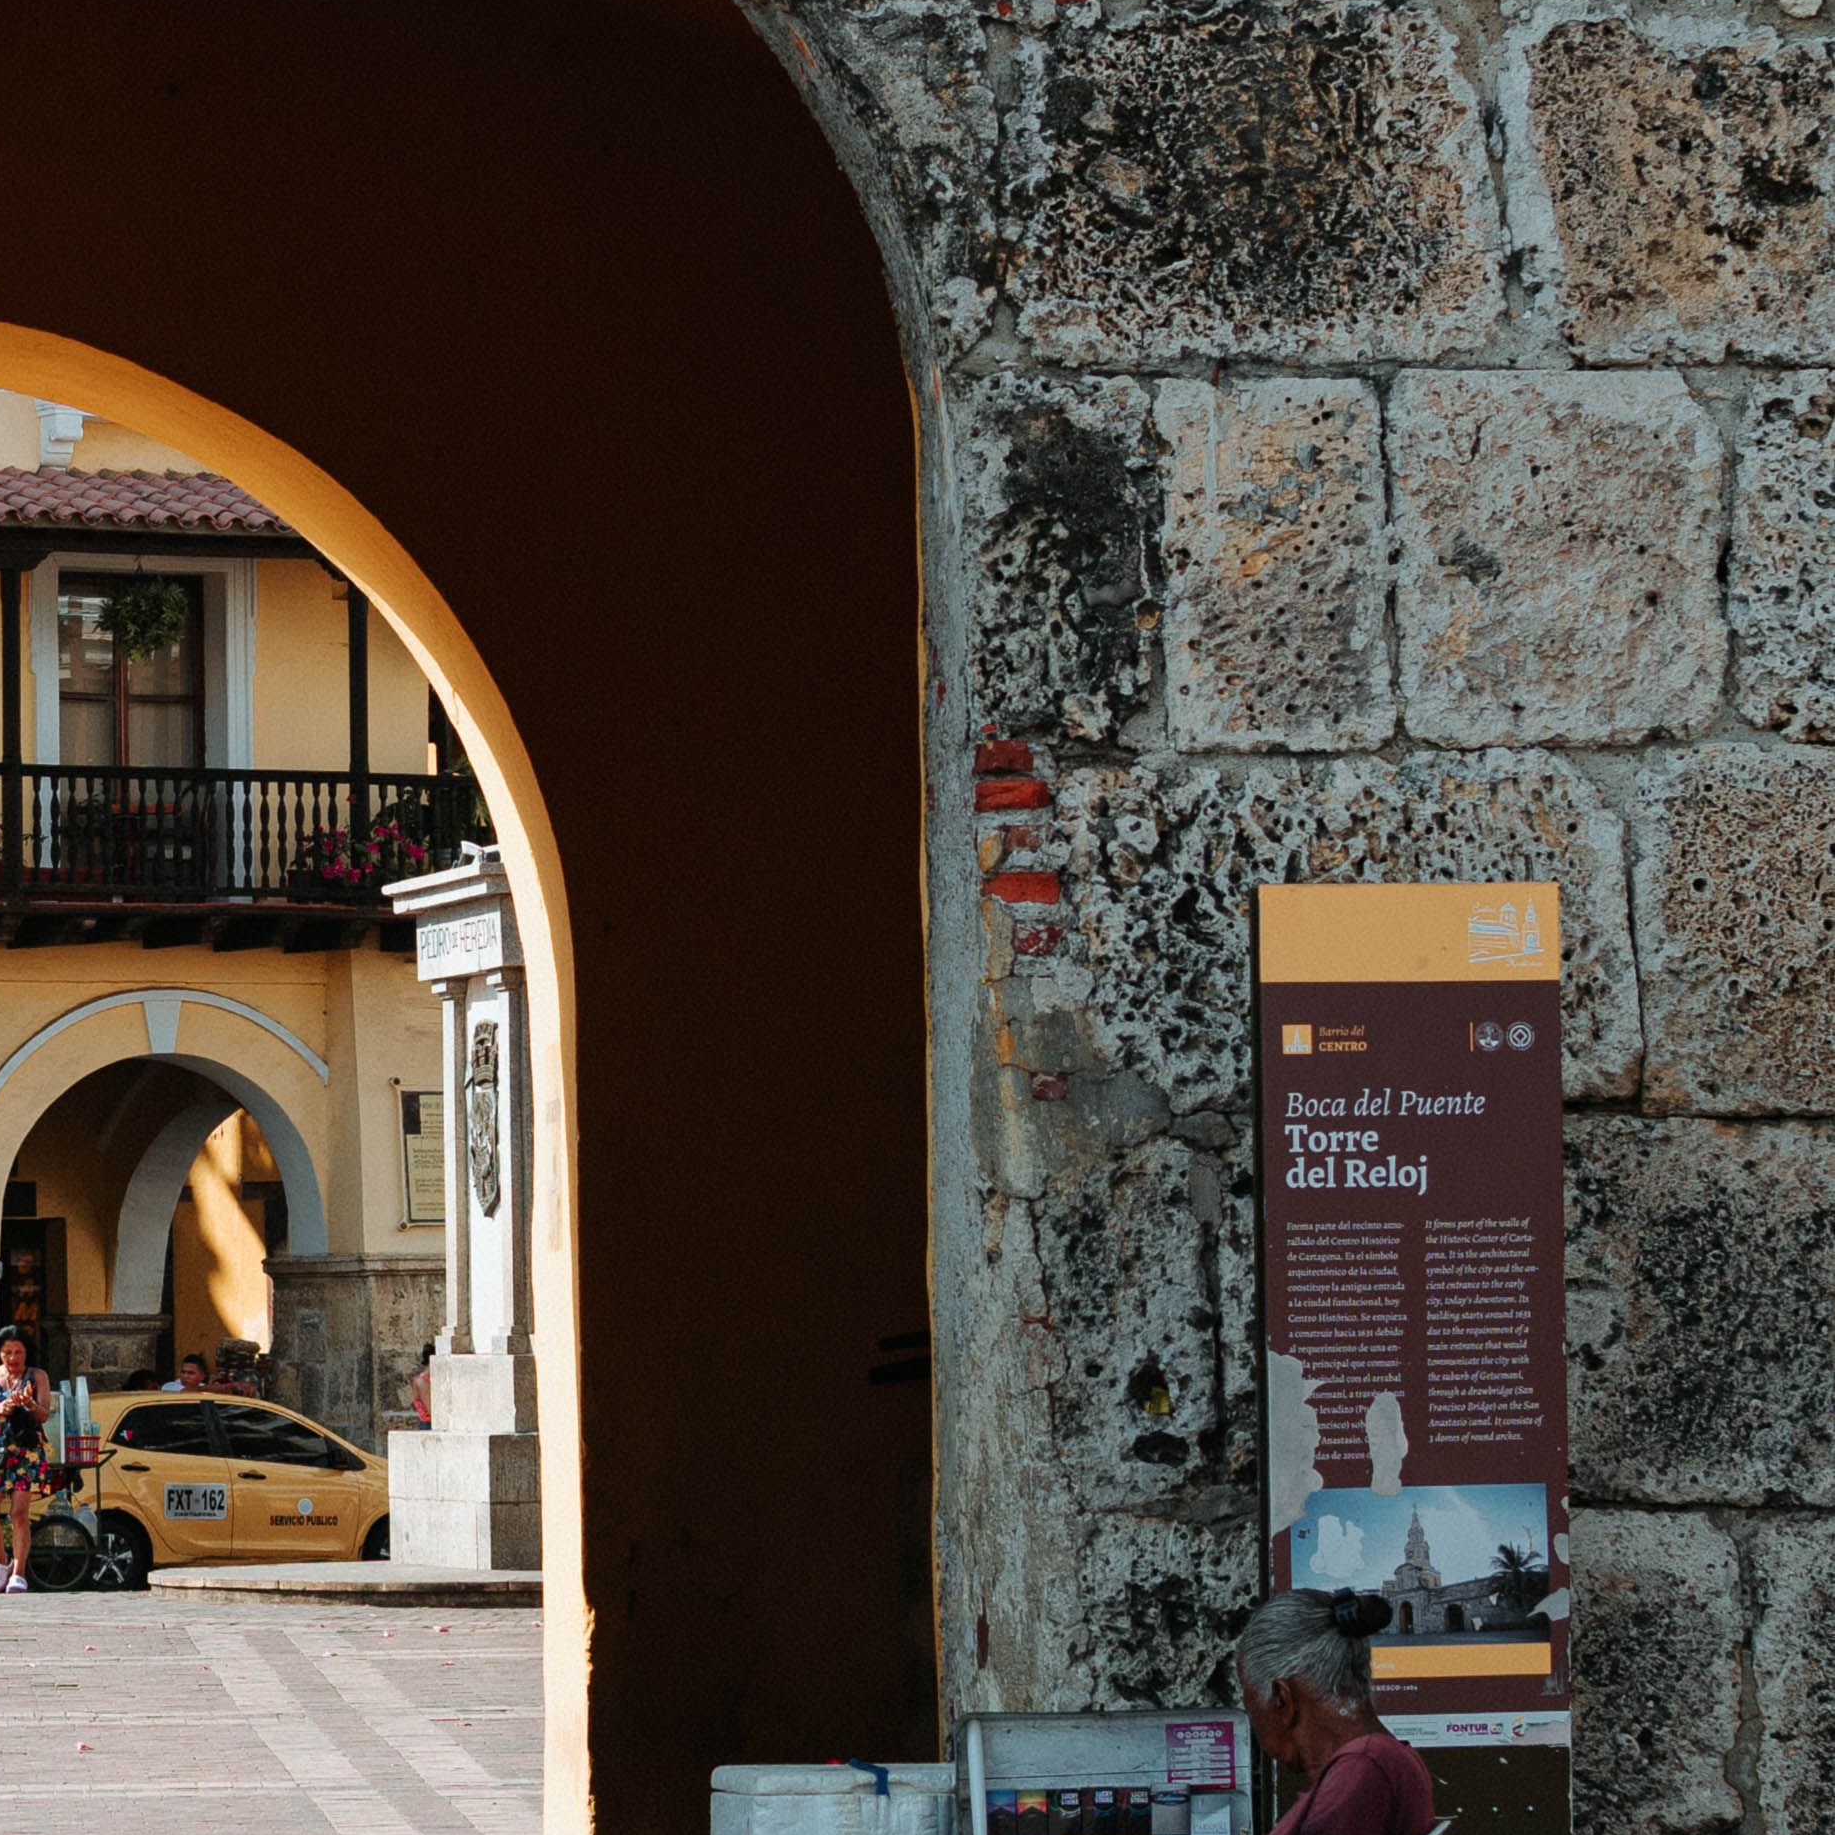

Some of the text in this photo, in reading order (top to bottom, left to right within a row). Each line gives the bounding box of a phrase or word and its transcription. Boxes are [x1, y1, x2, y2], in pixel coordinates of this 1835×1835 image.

[1319, 1024, 1365, 1037] Barrio del
[1318, 1041, 1367, 1052] CENTRO
[1285, 1088, 1486, 1118] Boca del Puente
[1284, 1123, 1379, 1153] Torre
[1285, 1154, 1428, 1196] del Reloj
[269, 1515, 305, 1526] SERVICIO
[1446, 1722, 1488, 1733] FONTUR
